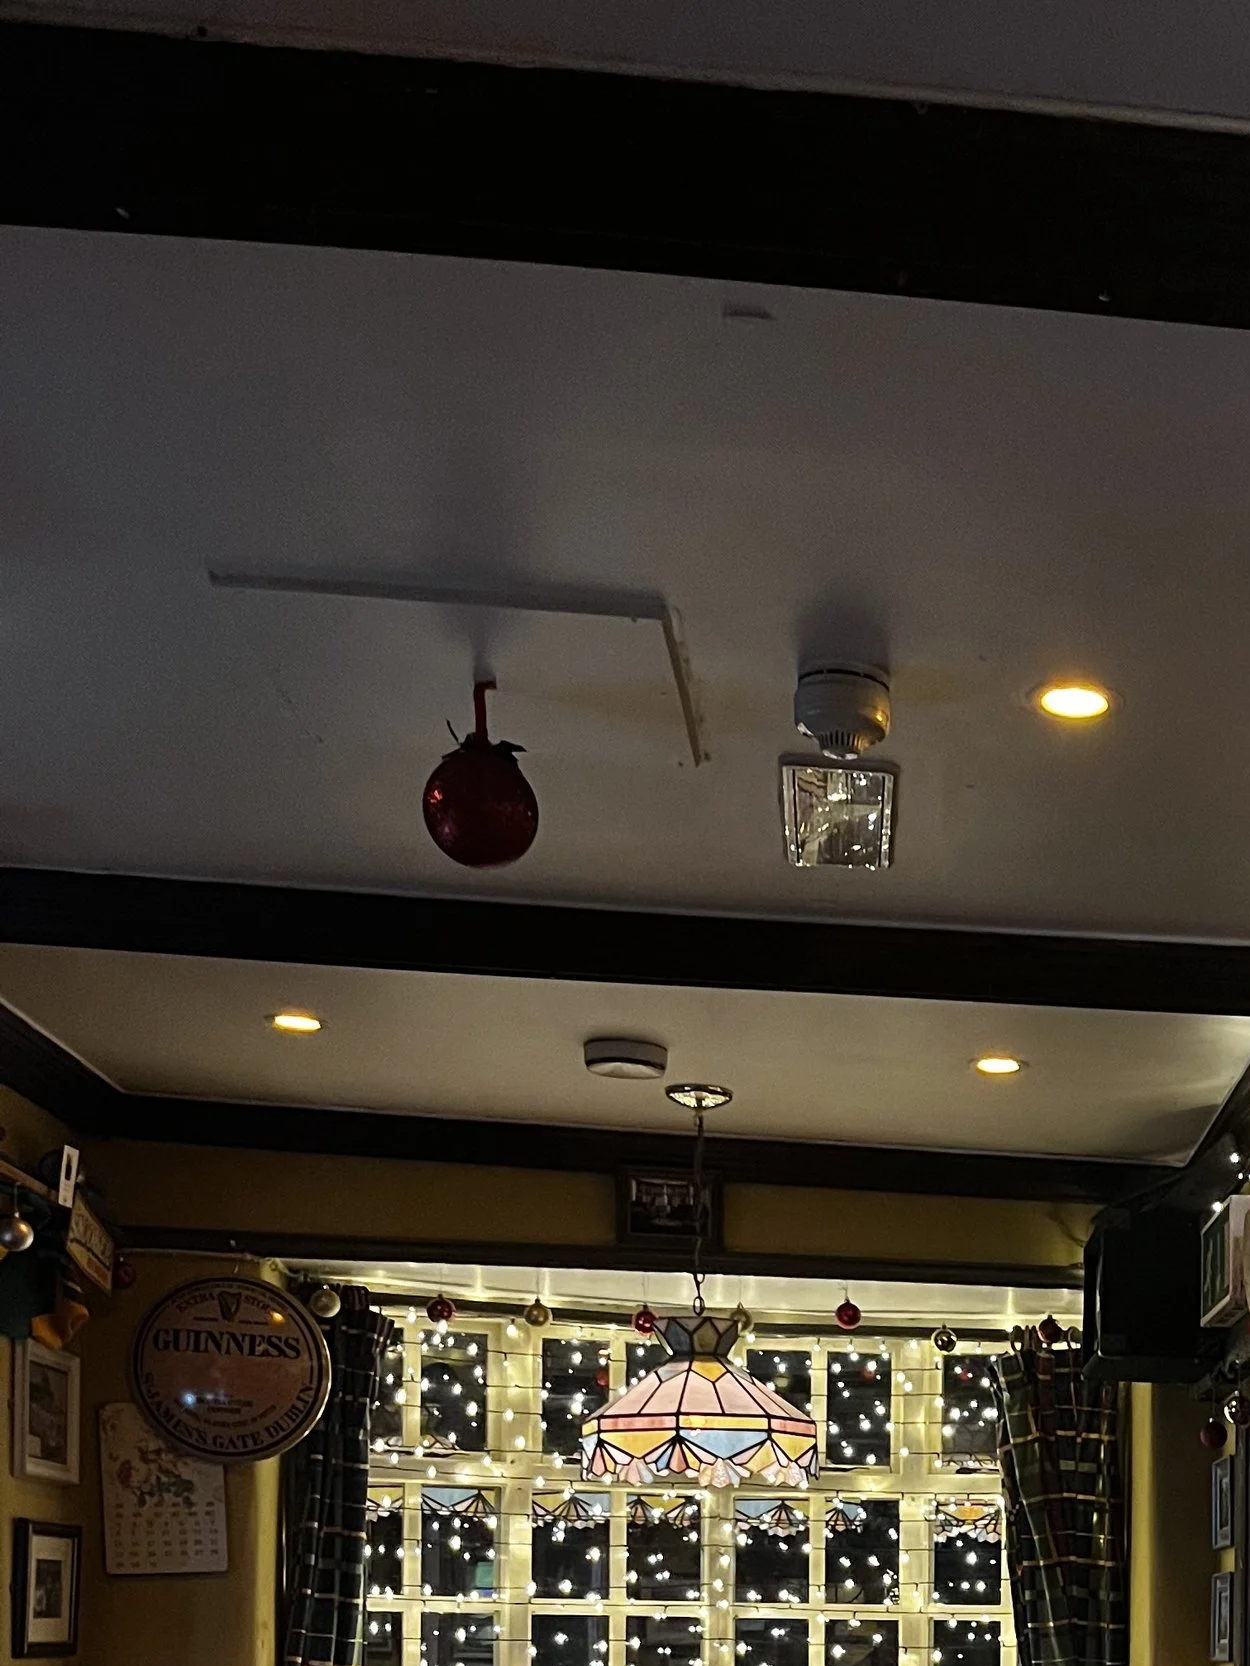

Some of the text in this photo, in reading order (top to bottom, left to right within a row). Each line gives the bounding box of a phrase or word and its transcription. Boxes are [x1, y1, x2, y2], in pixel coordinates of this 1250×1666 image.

[153, 1328, 302, 1360] GUINNESS
[212, 1431, 265, 1450] GATE
[264, 1385, 315, 1439] DUBLIN
